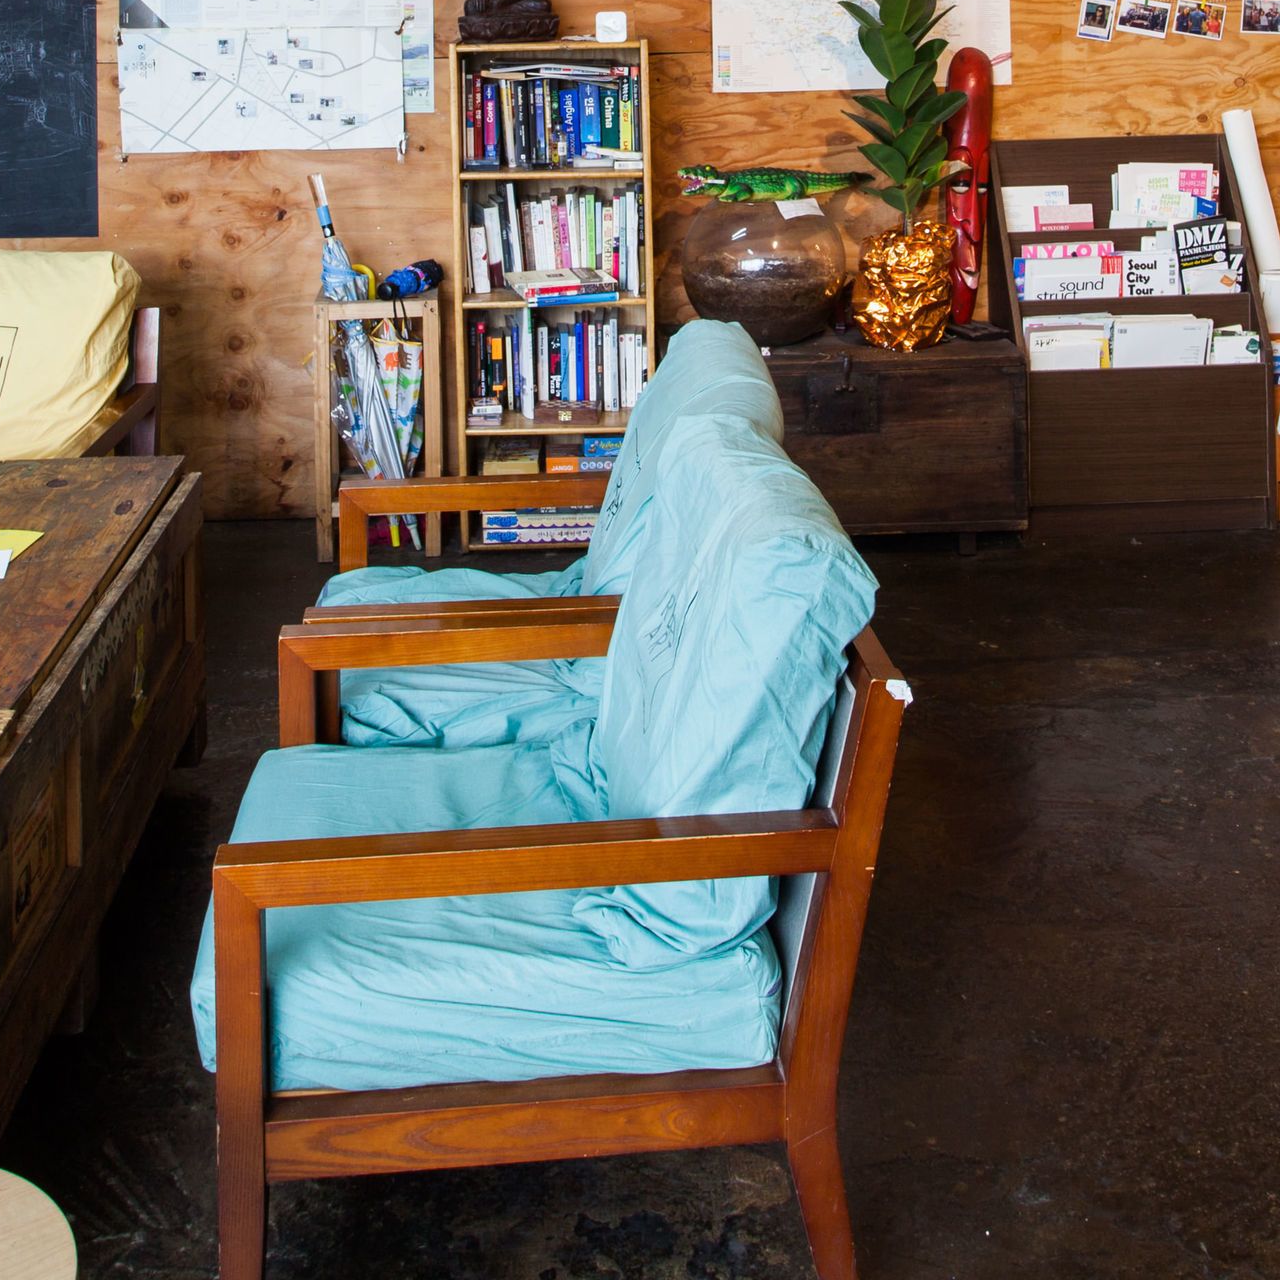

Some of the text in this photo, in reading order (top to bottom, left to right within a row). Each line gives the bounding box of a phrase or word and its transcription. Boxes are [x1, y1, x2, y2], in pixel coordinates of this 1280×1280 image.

[563, 94, 575, 125] Anglais
[604, 96, 615, 129] China
[1176, 223, 1226, 249] DMZ
[1022, 242, 1113, 258] NYLON
[1180, 243, 1226, 258] PANMUNJEOM
[1128, 259, 1158, 271] Seoul
[1059, 278, 1105, 293] sound
[1127, 272, 1151, 285] City
[1036, 290, 1079, 300] struct
[1128, 285, 1155, 295] Tour
